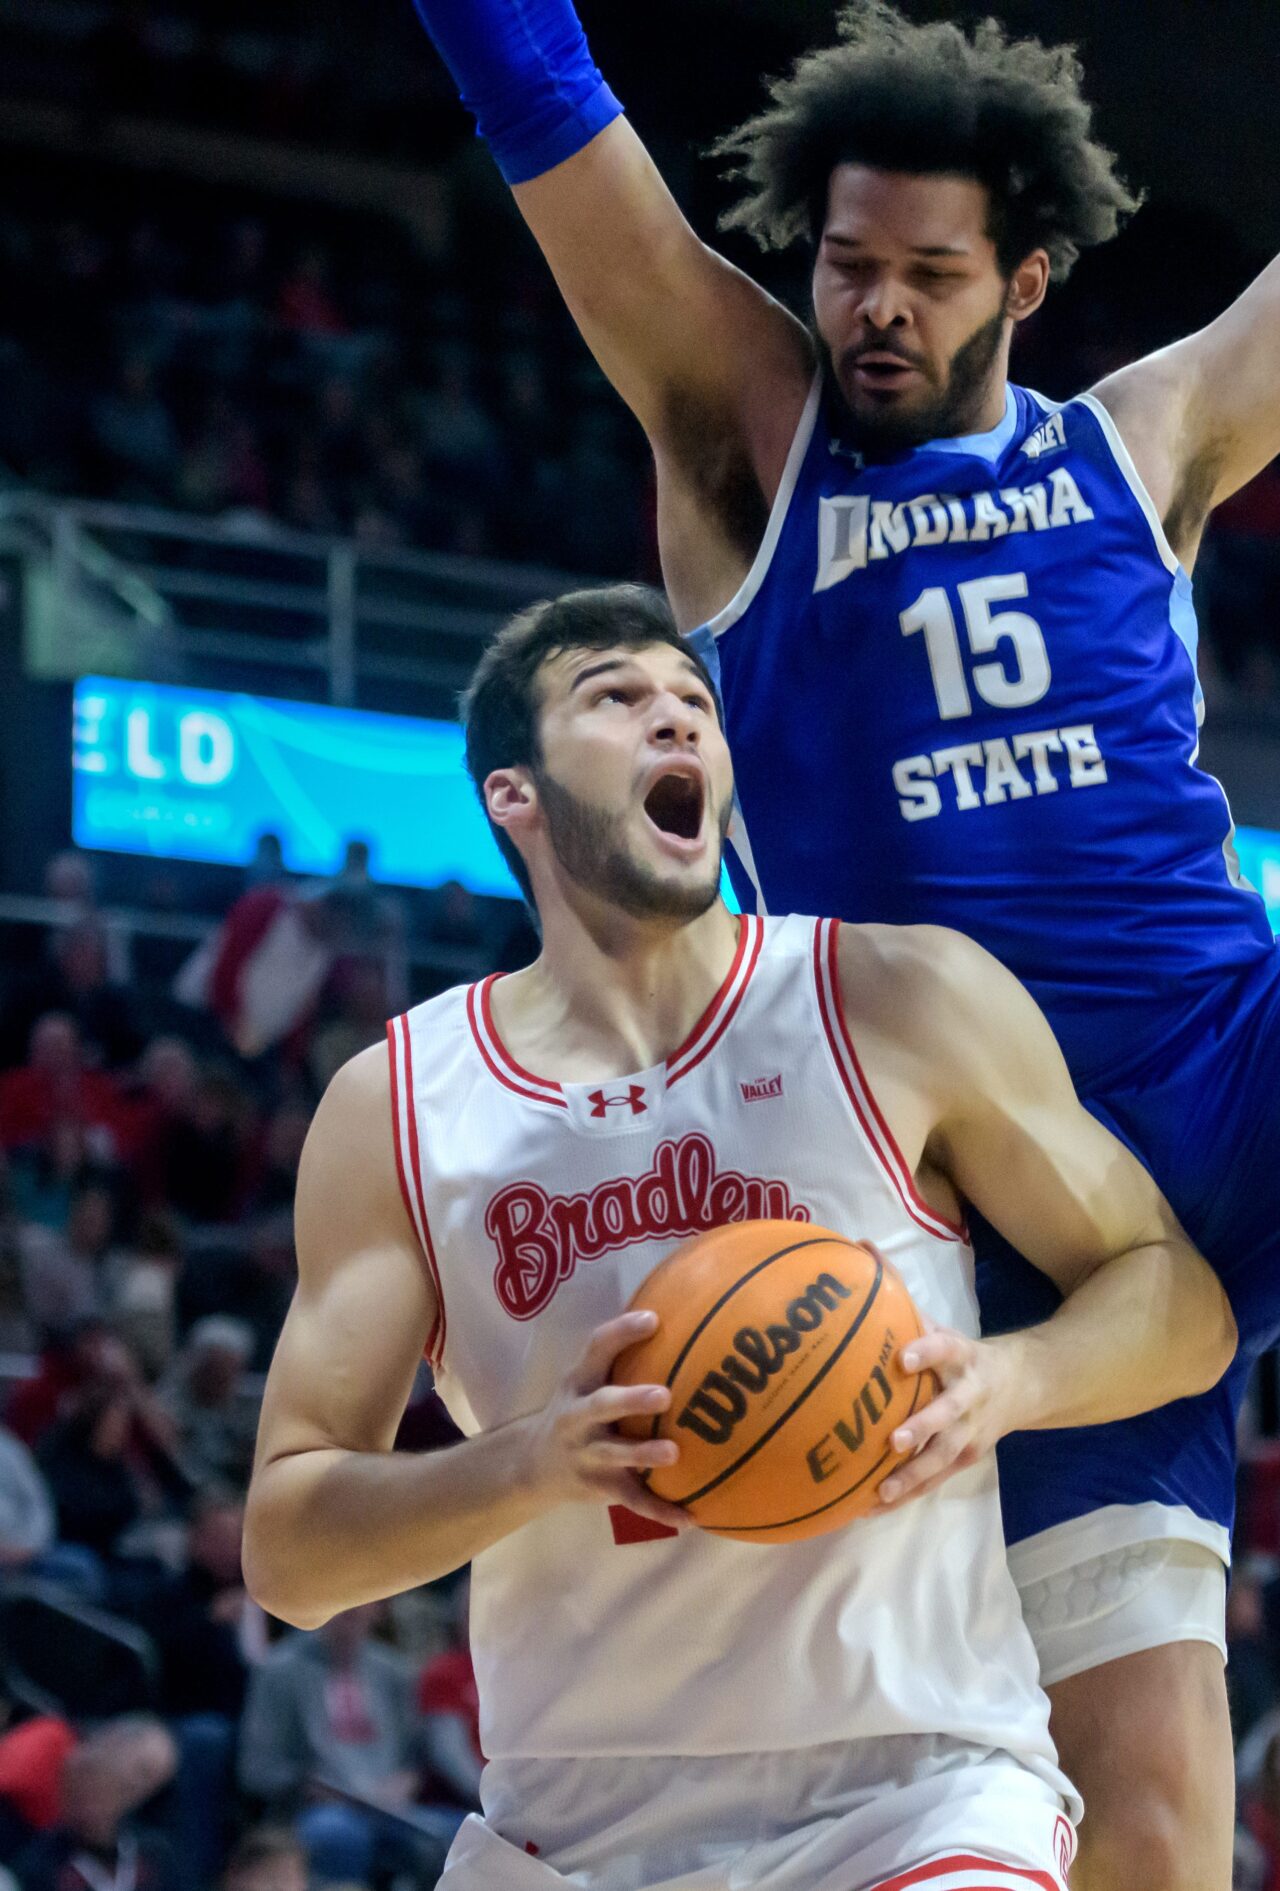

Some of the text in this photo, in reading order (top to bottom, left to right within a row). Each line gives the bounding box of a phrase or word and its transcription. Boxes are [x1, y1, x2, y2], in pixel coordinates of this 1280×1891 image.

[813, 468, 1094, 594] INDIANA
[900, 572, 1051, 721] 15
[892, 724, 1108, 822] STATE
[740, 1073, 783, 1100] VALLEY
[676, 1272, 852, 1445] Wilson
[805, 1365, 893, 1484] EVO
